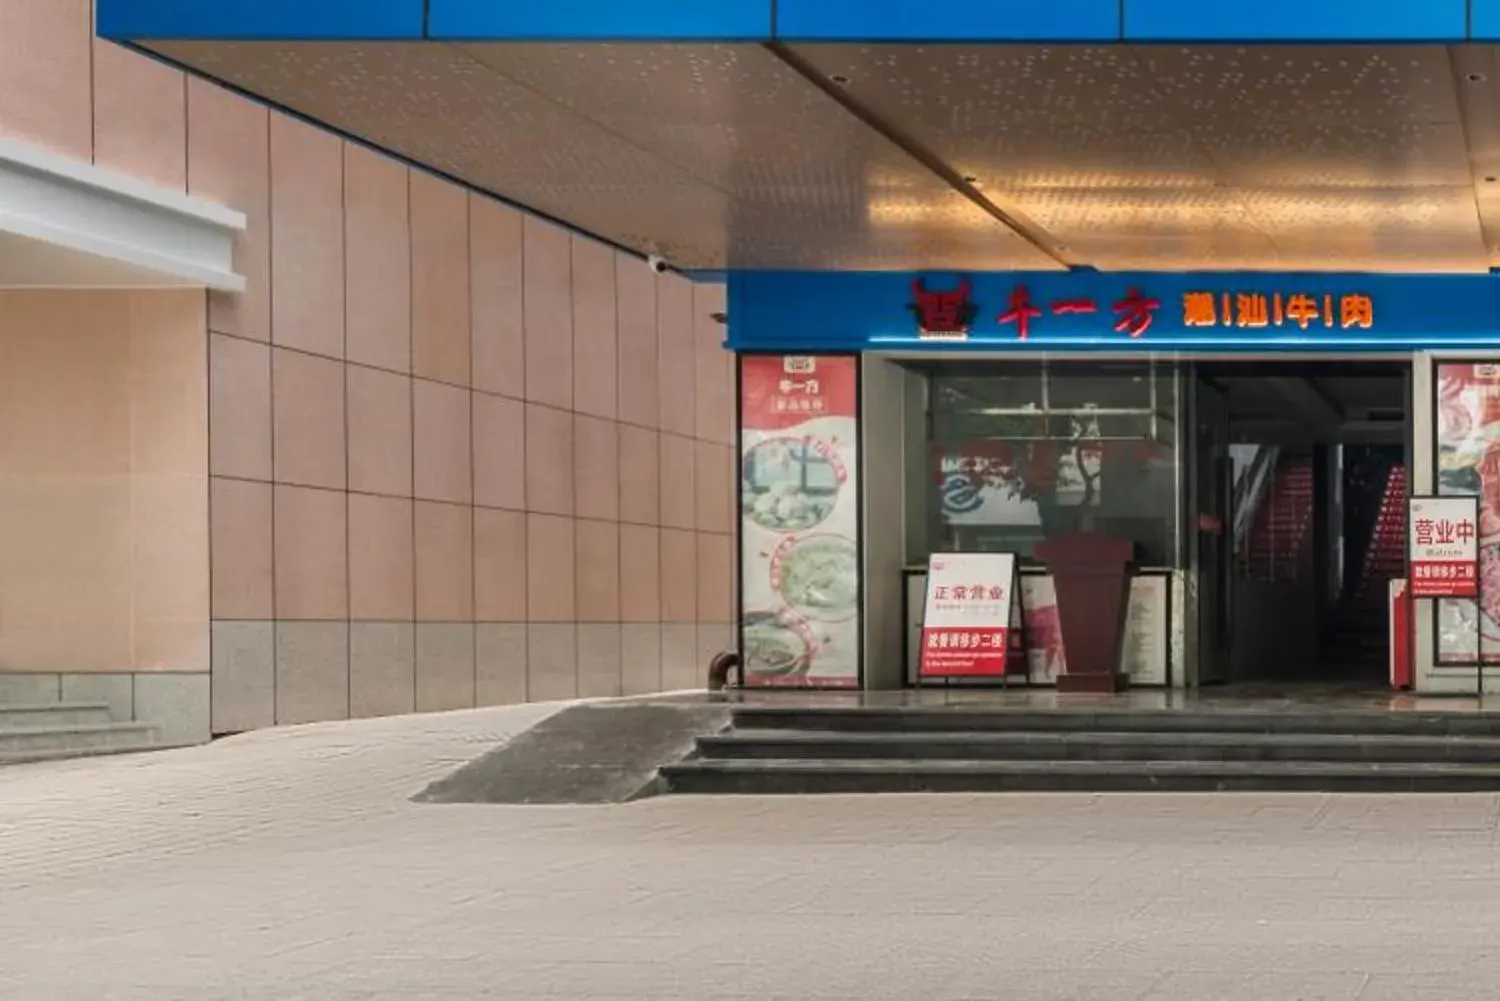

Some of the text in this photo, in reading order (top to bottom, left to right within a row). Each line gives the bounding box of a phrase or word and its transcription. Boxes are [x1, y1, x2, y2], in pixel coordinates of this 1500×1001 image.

[997, 282, 1160, 341] 牛一方
[1414, 518, 1475, 546] 营业中
[934, 584, 1004, 600] 正常营业
